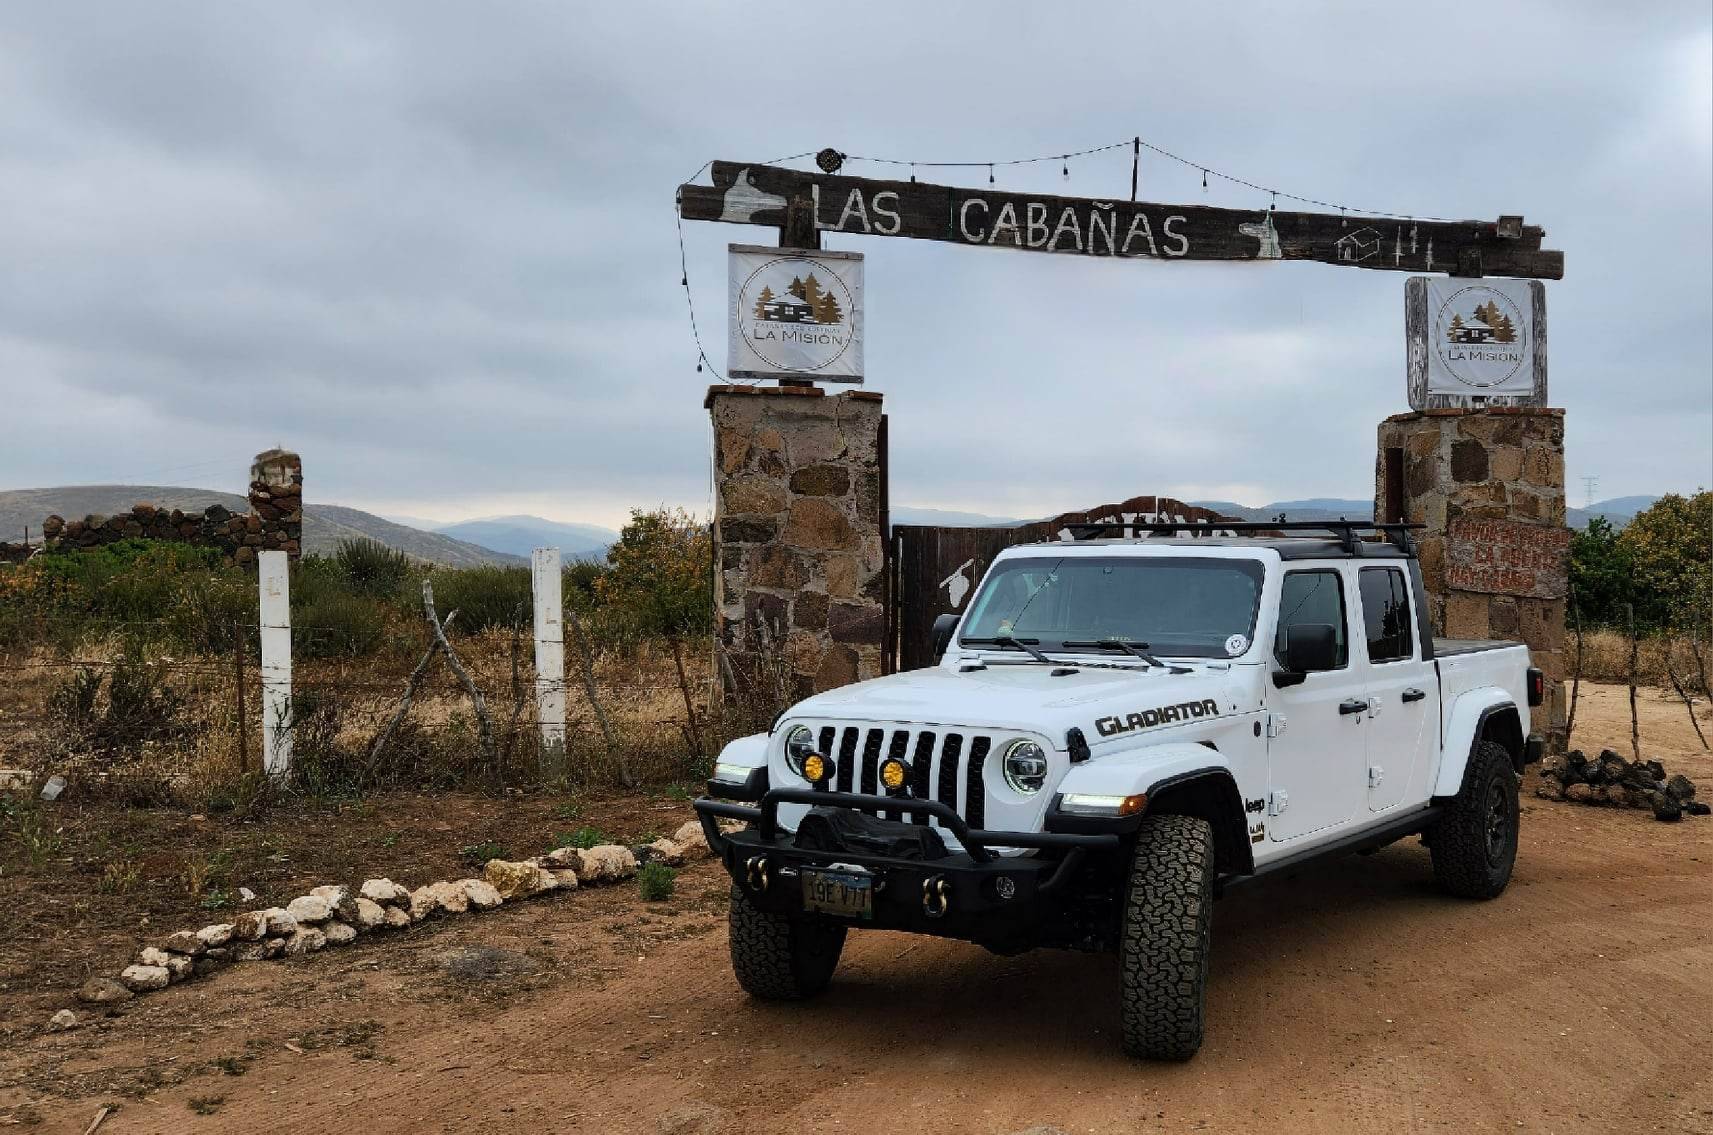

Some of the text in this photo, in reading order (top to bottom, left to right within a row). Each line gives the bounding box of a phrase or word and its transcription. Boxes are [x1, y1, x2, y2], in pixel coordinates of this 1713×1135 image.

[812, 183, 1190, 256] LAS CABAÑAS
[754, 328, 776, 340] LA
[1448, 349, 1466, 361] LA
[1095, 699, 1220, 737] GLADIATOR
